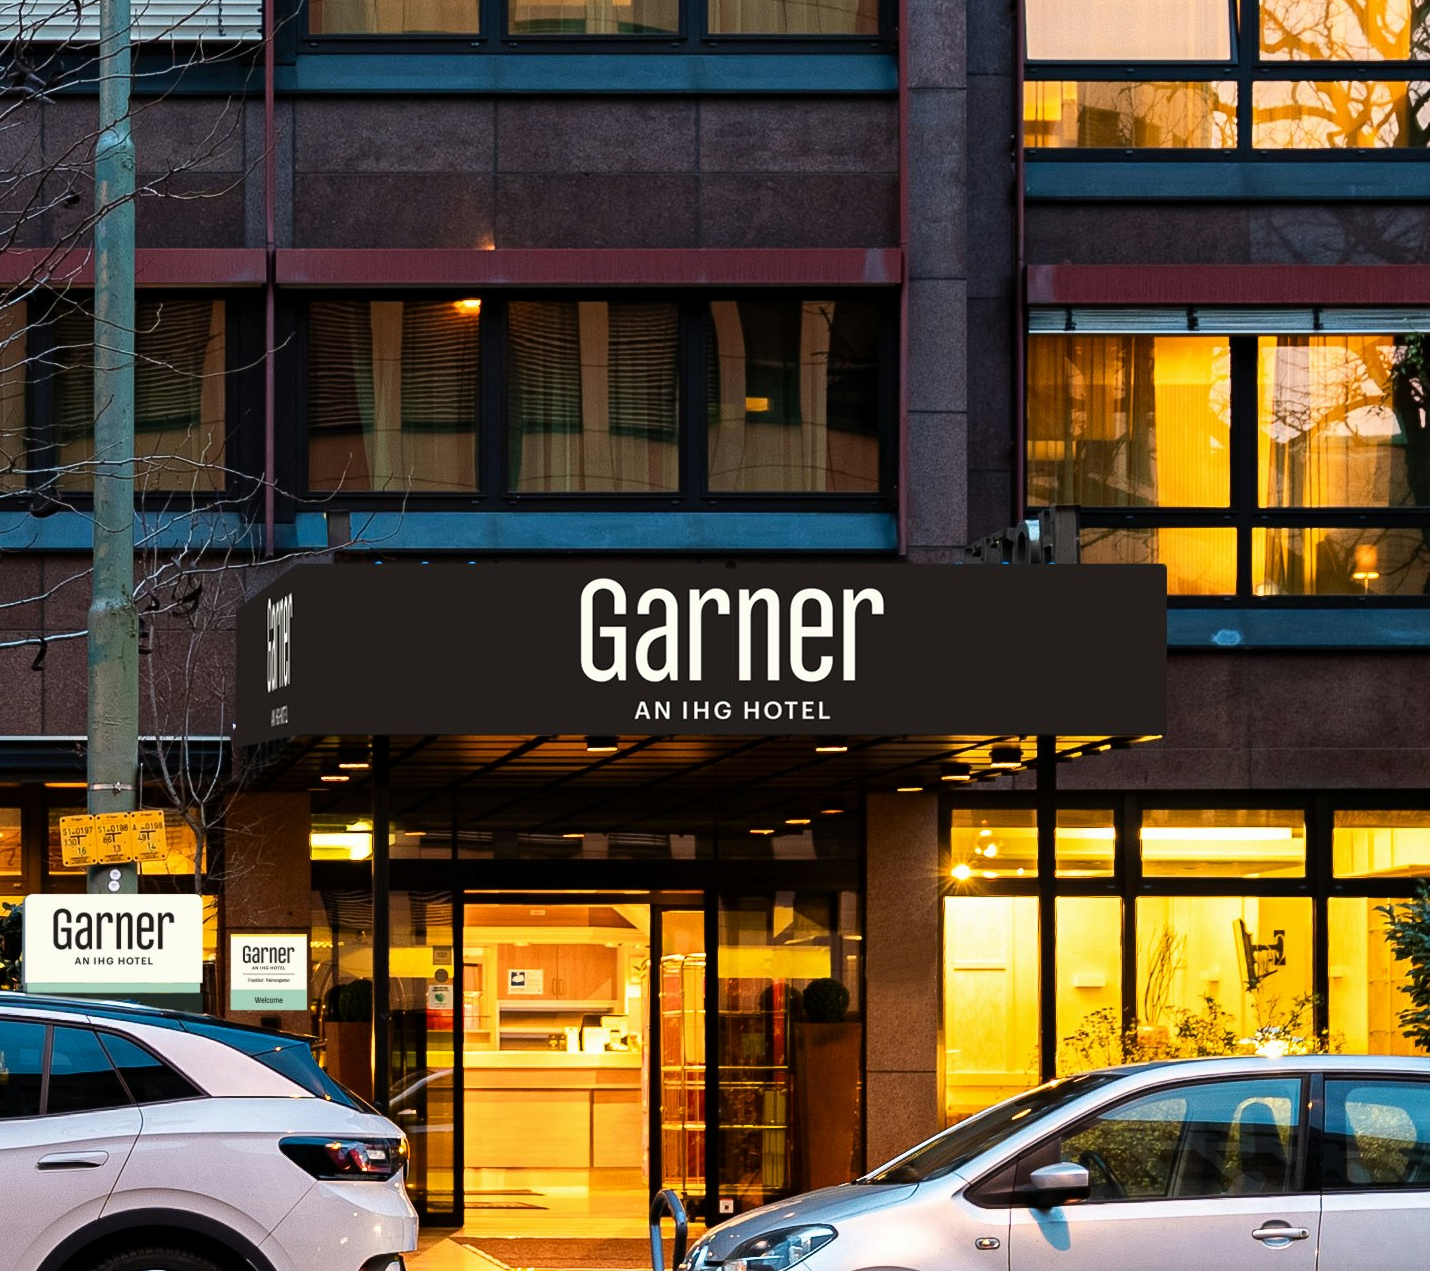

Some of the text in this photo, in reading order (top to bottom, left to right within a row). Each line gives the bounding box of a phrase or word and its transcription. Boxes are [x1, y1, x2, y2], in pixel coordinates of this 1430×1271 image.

[580, 577, 885, 683] Garner
[634, 701, 831, 720] AN IHG HOTEL
[53, 908, 175, 950] Garner
[74, 957, 153, 965] AN IHG HOTEL
[242, 945, 295, 964] Garner
[254, 996, 284, 1004] Welcome
